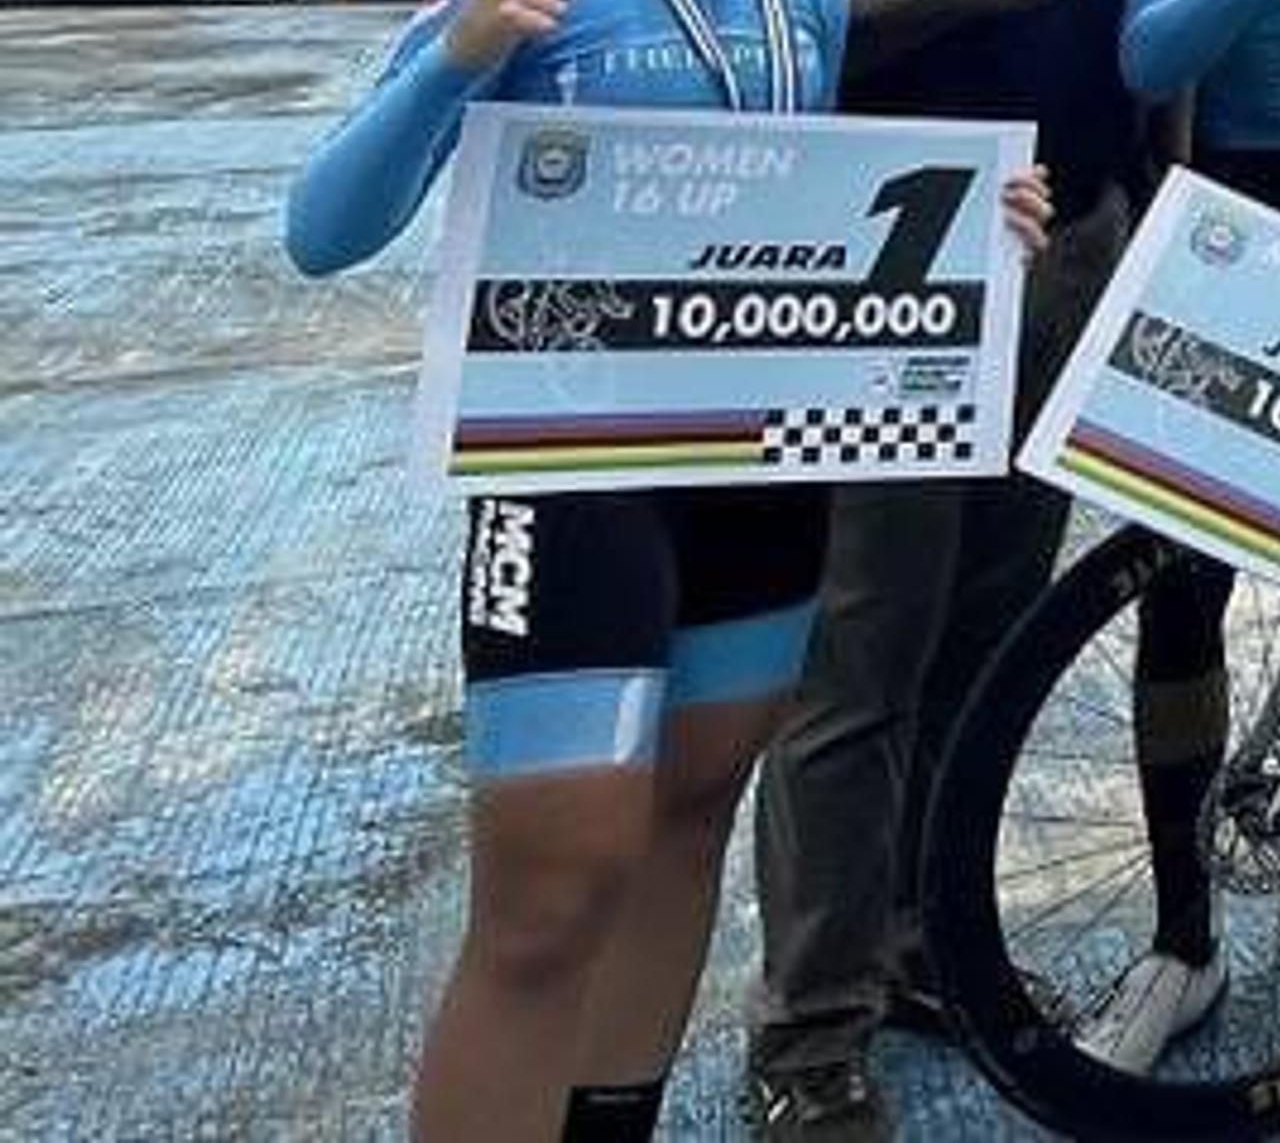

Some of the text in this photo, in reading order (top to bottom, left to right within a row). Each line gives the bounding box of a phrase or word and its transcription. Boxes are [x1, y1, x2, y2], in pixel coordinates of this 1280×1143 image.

[614, 142, 798, 180] WOMEN
[613, 180, 737, 216] 16 UP
[866, 166, 979, 292] 1
[689, 242, 847, 272] JUARA
[650, 291, 958, 344] 10,000,000
[490, 499, 535, 637] MCM
